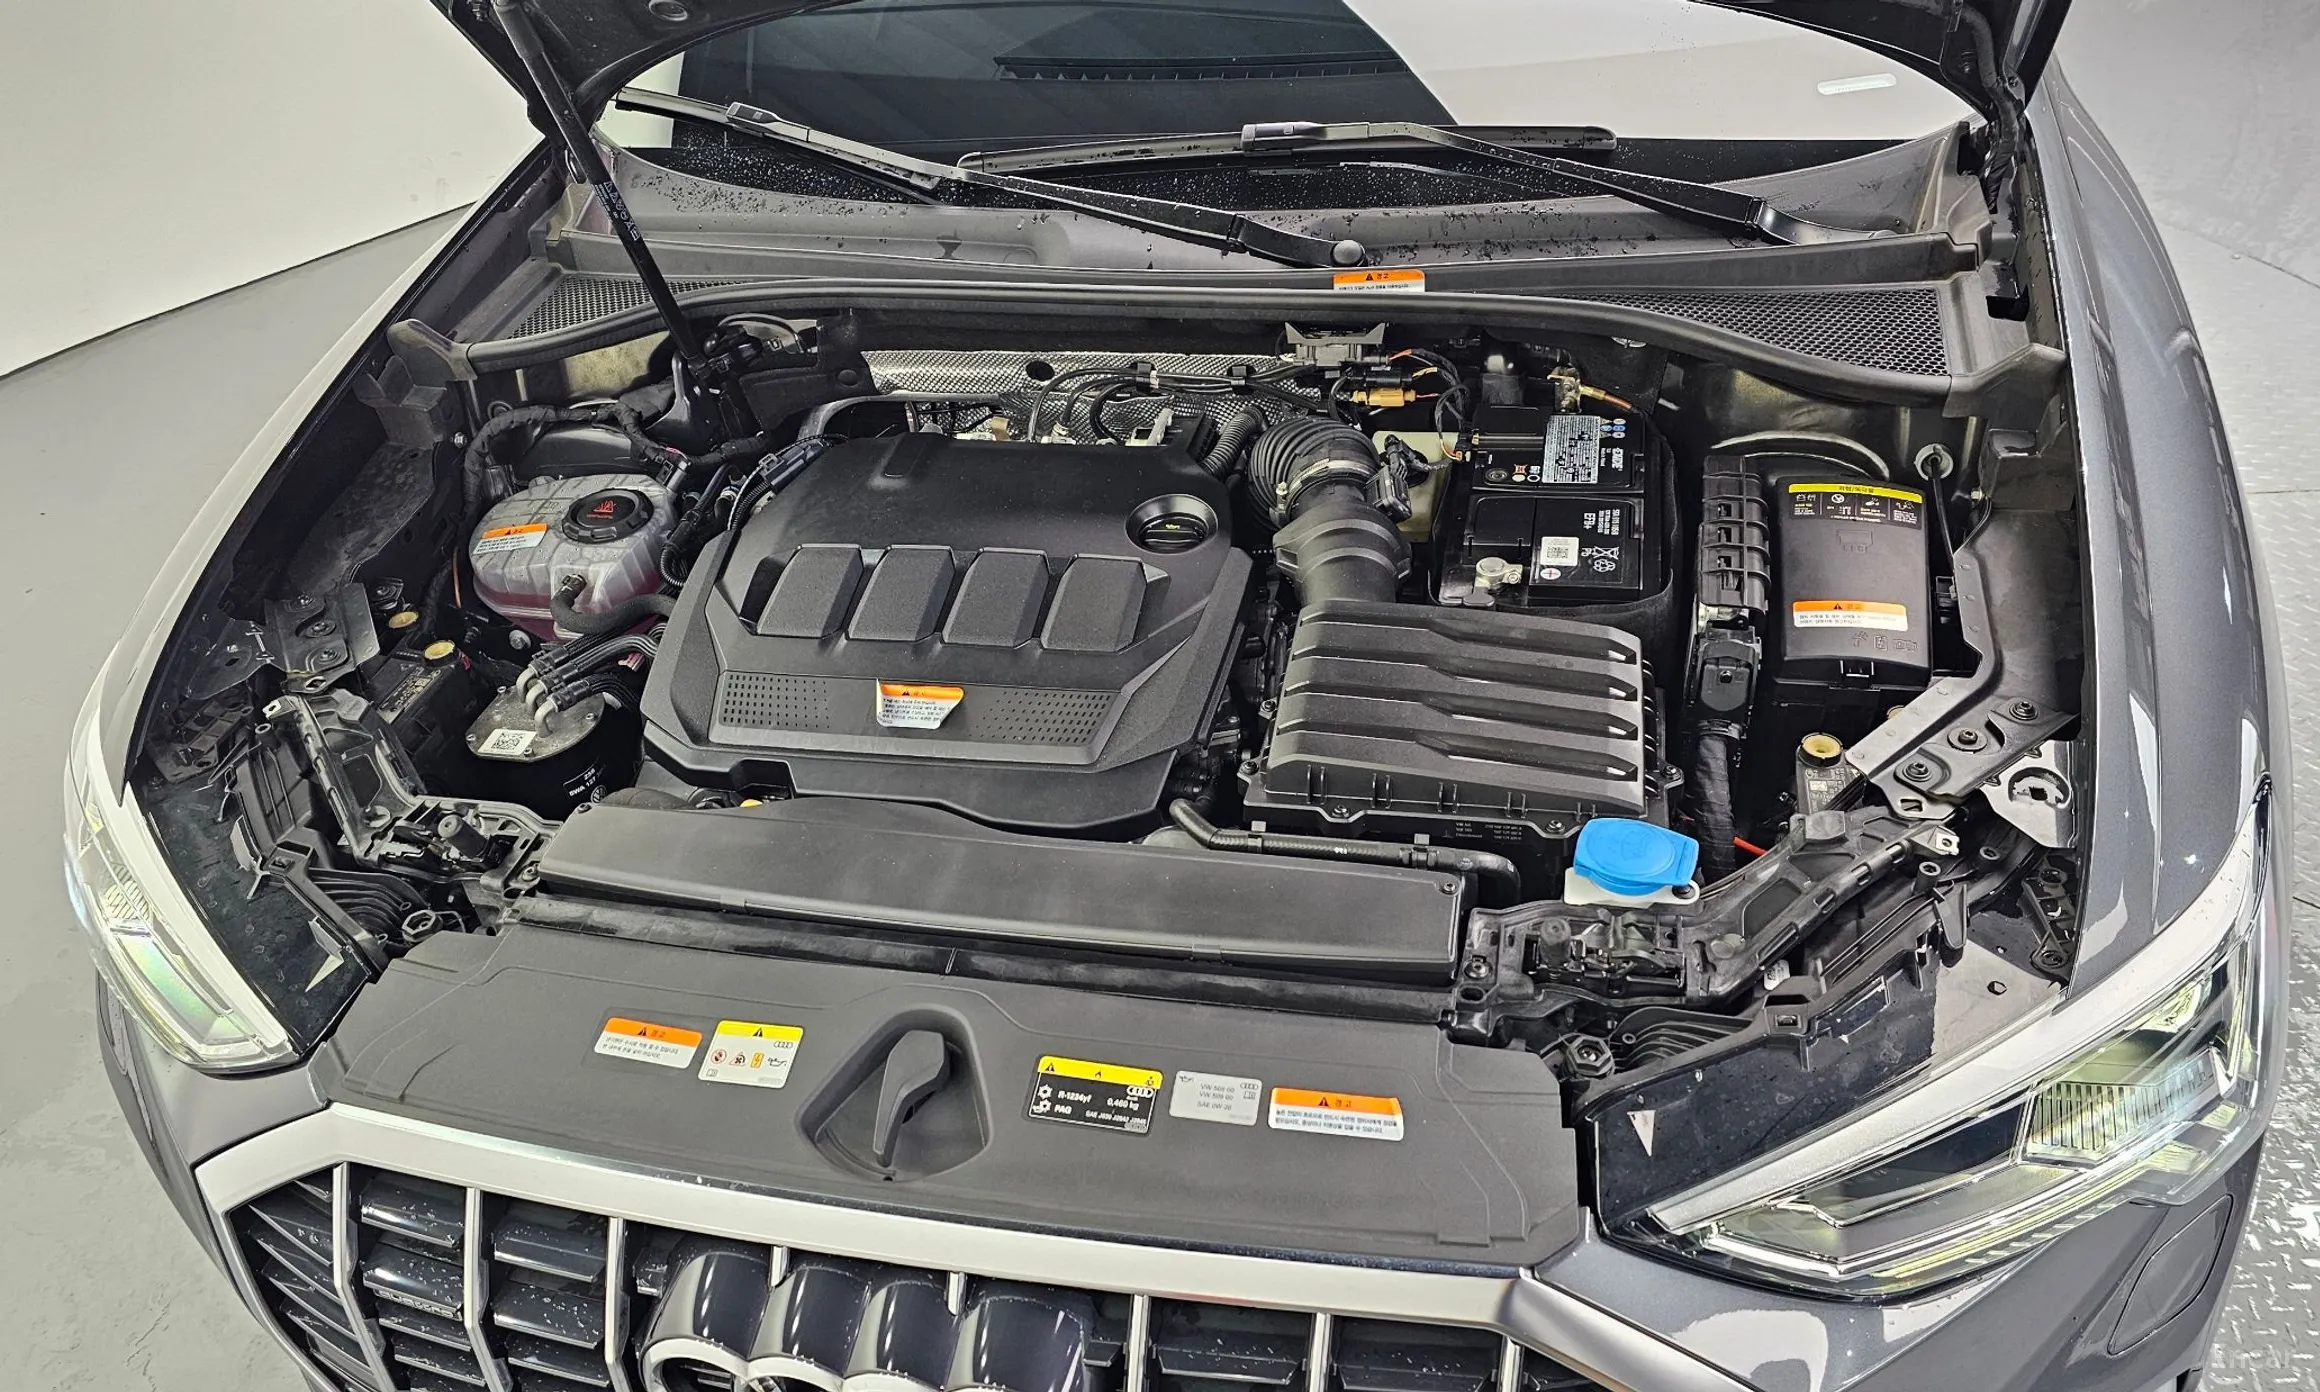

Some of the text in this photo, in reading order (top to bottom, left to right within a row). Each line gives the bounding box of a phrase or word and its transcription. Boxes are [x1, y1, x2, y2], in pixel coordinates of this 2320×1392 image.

[1057, 1090, 1092, 1104] R-1234yf
[1054, 1104, 1072, 1114] PAG
[1129, 1101, 1139, 1111] kg
[1085, 1110, 1098, 1118] SAE
